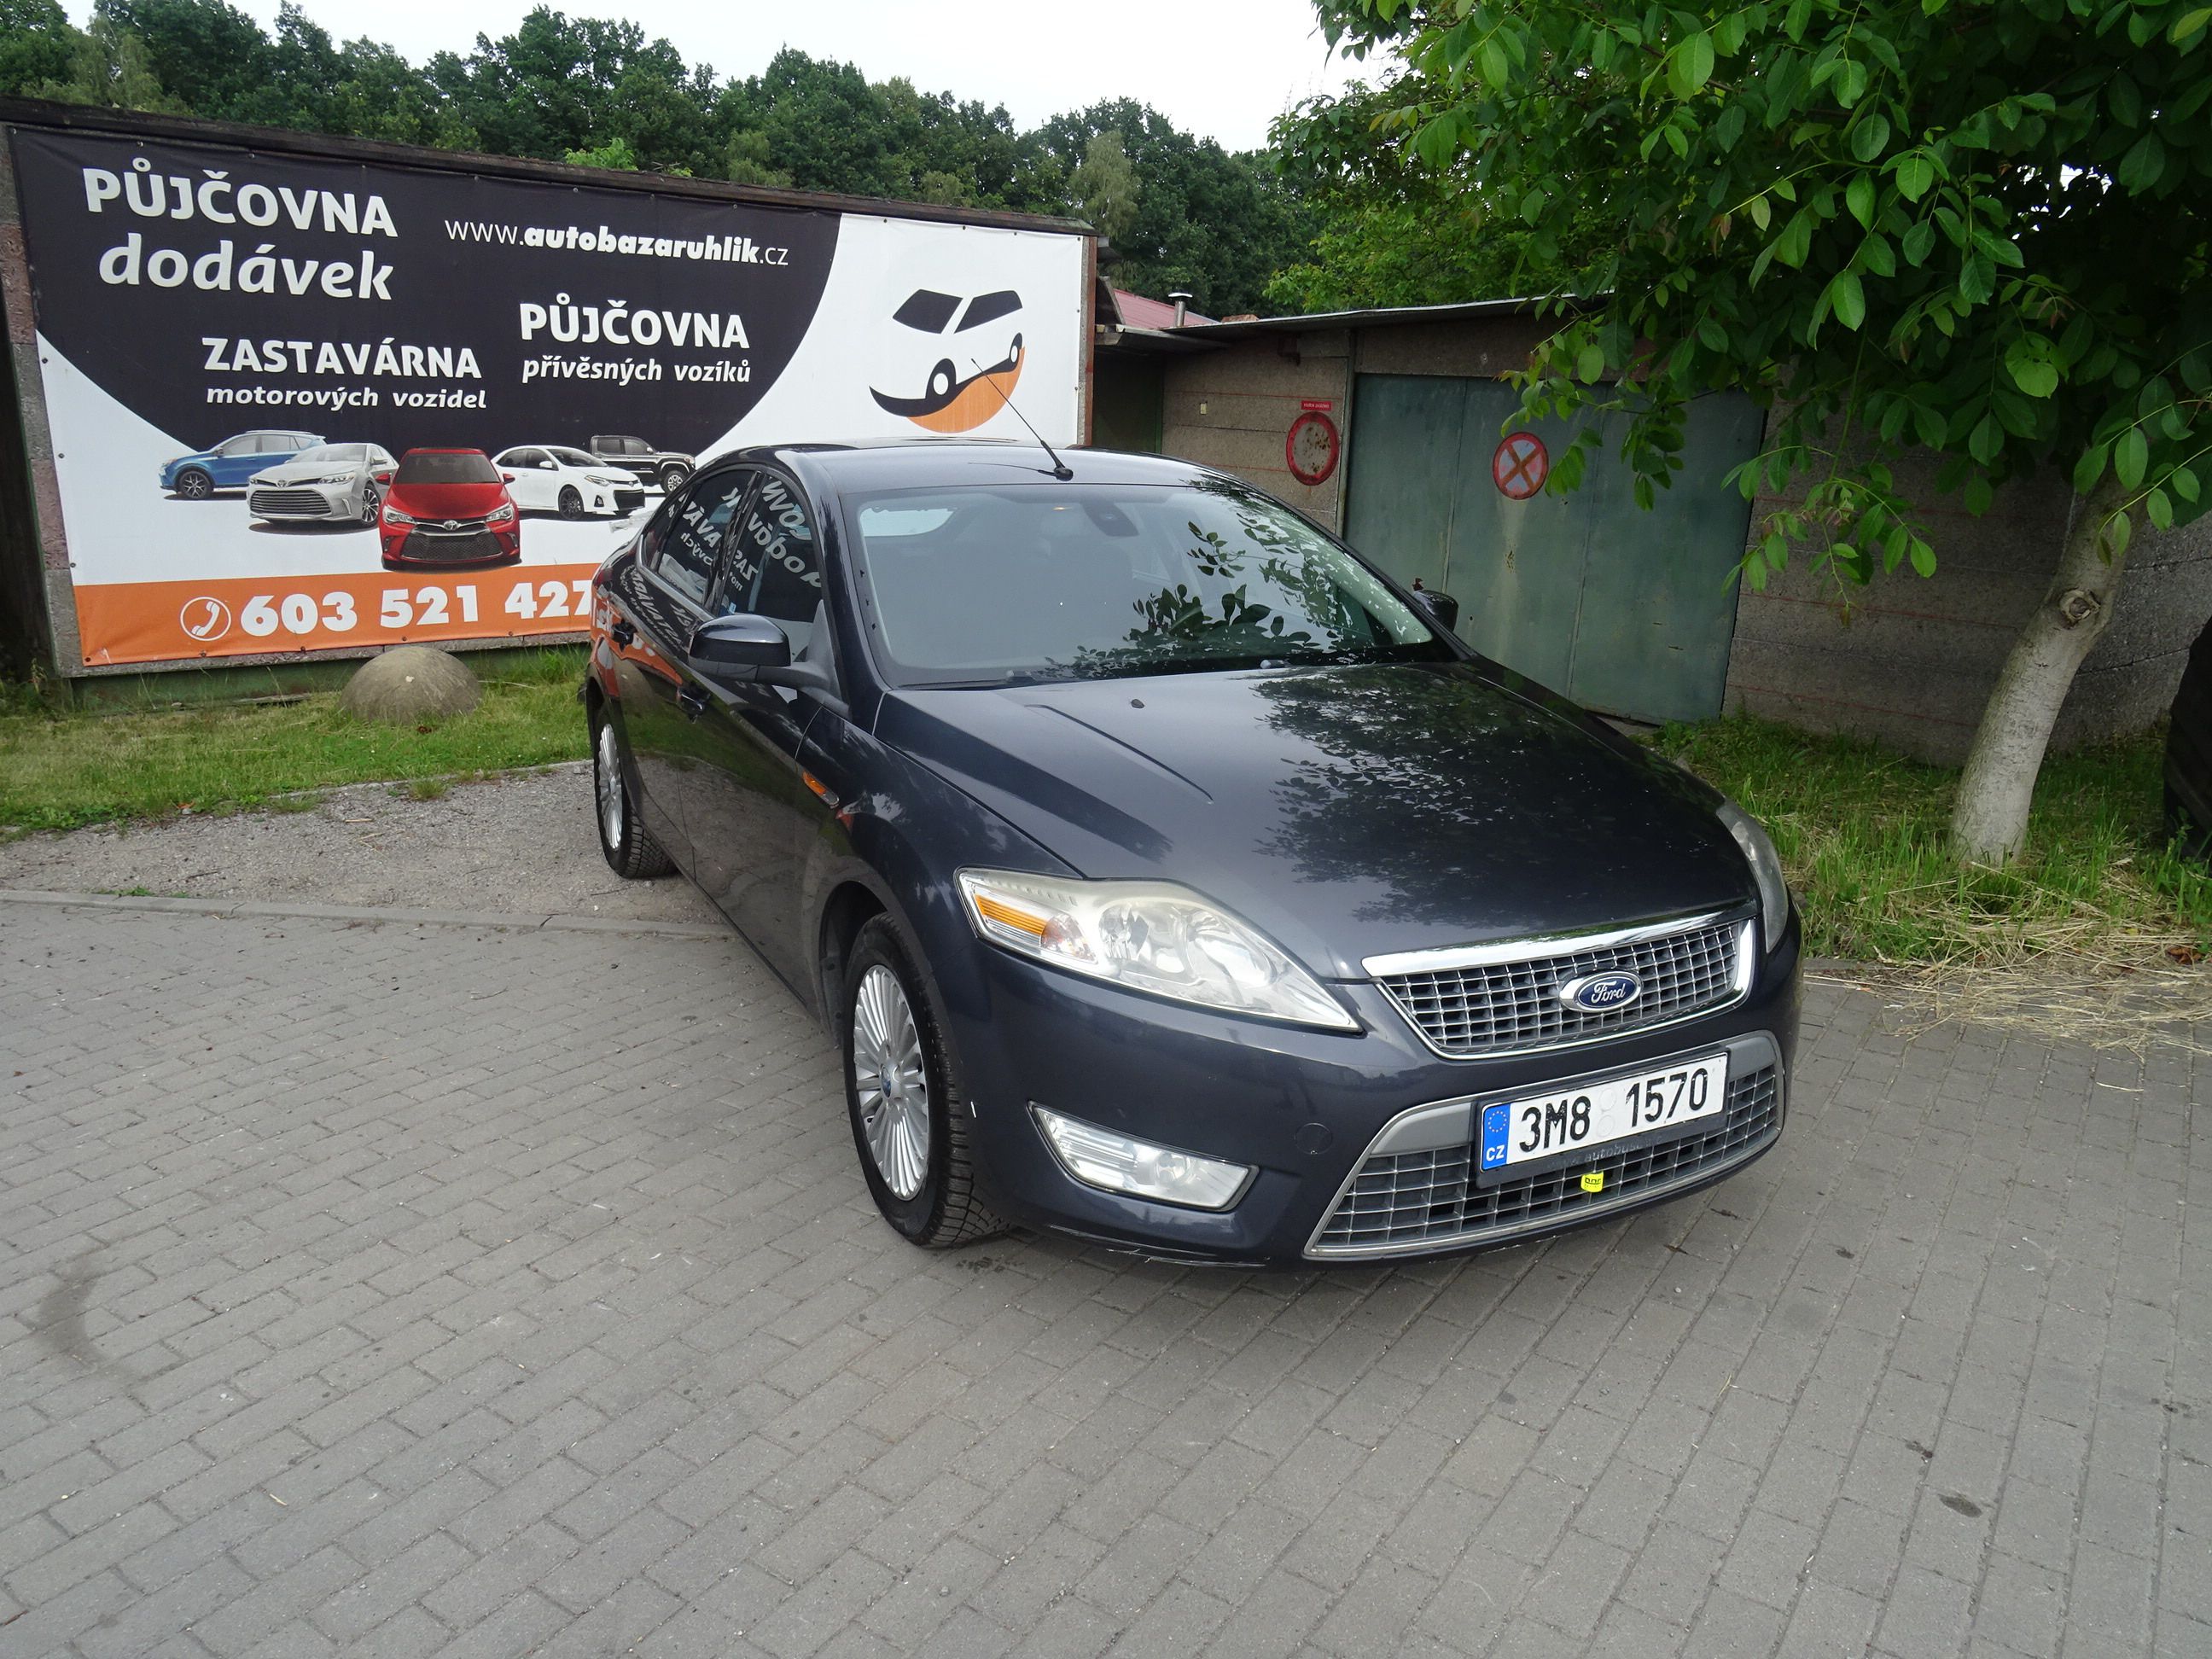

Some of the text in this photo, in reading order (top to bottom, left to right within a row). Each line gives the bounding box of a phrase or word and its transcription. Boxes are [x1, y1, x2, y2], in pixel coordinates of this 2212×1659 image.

[83, 157, 398, 238] PŮJČOVNA
[445, 219, 789, 265] www.autobazaruhlik.cz
[99, 232, 395, 300] dodávek
[520, 292, 750, 349] PŮJČOVNA
[201, 337, 482, 379] ZASTAVÁRNA
[521, 354, 751, 387] přívěsných vozíků
[207, 386, 487, 411] motorových vozidel
[241, 591, 358, 637] 603
[380, 585, 479, 628] 521
[504, 580, 592, 619] 427
[1591, 981, 1627, 1004] Ford
[1519, 1096, 1592, 1153] 3M8
[1625, 1068, 1708, 1127] 1570
[1486, 1144, 1505, 1162] CZ
